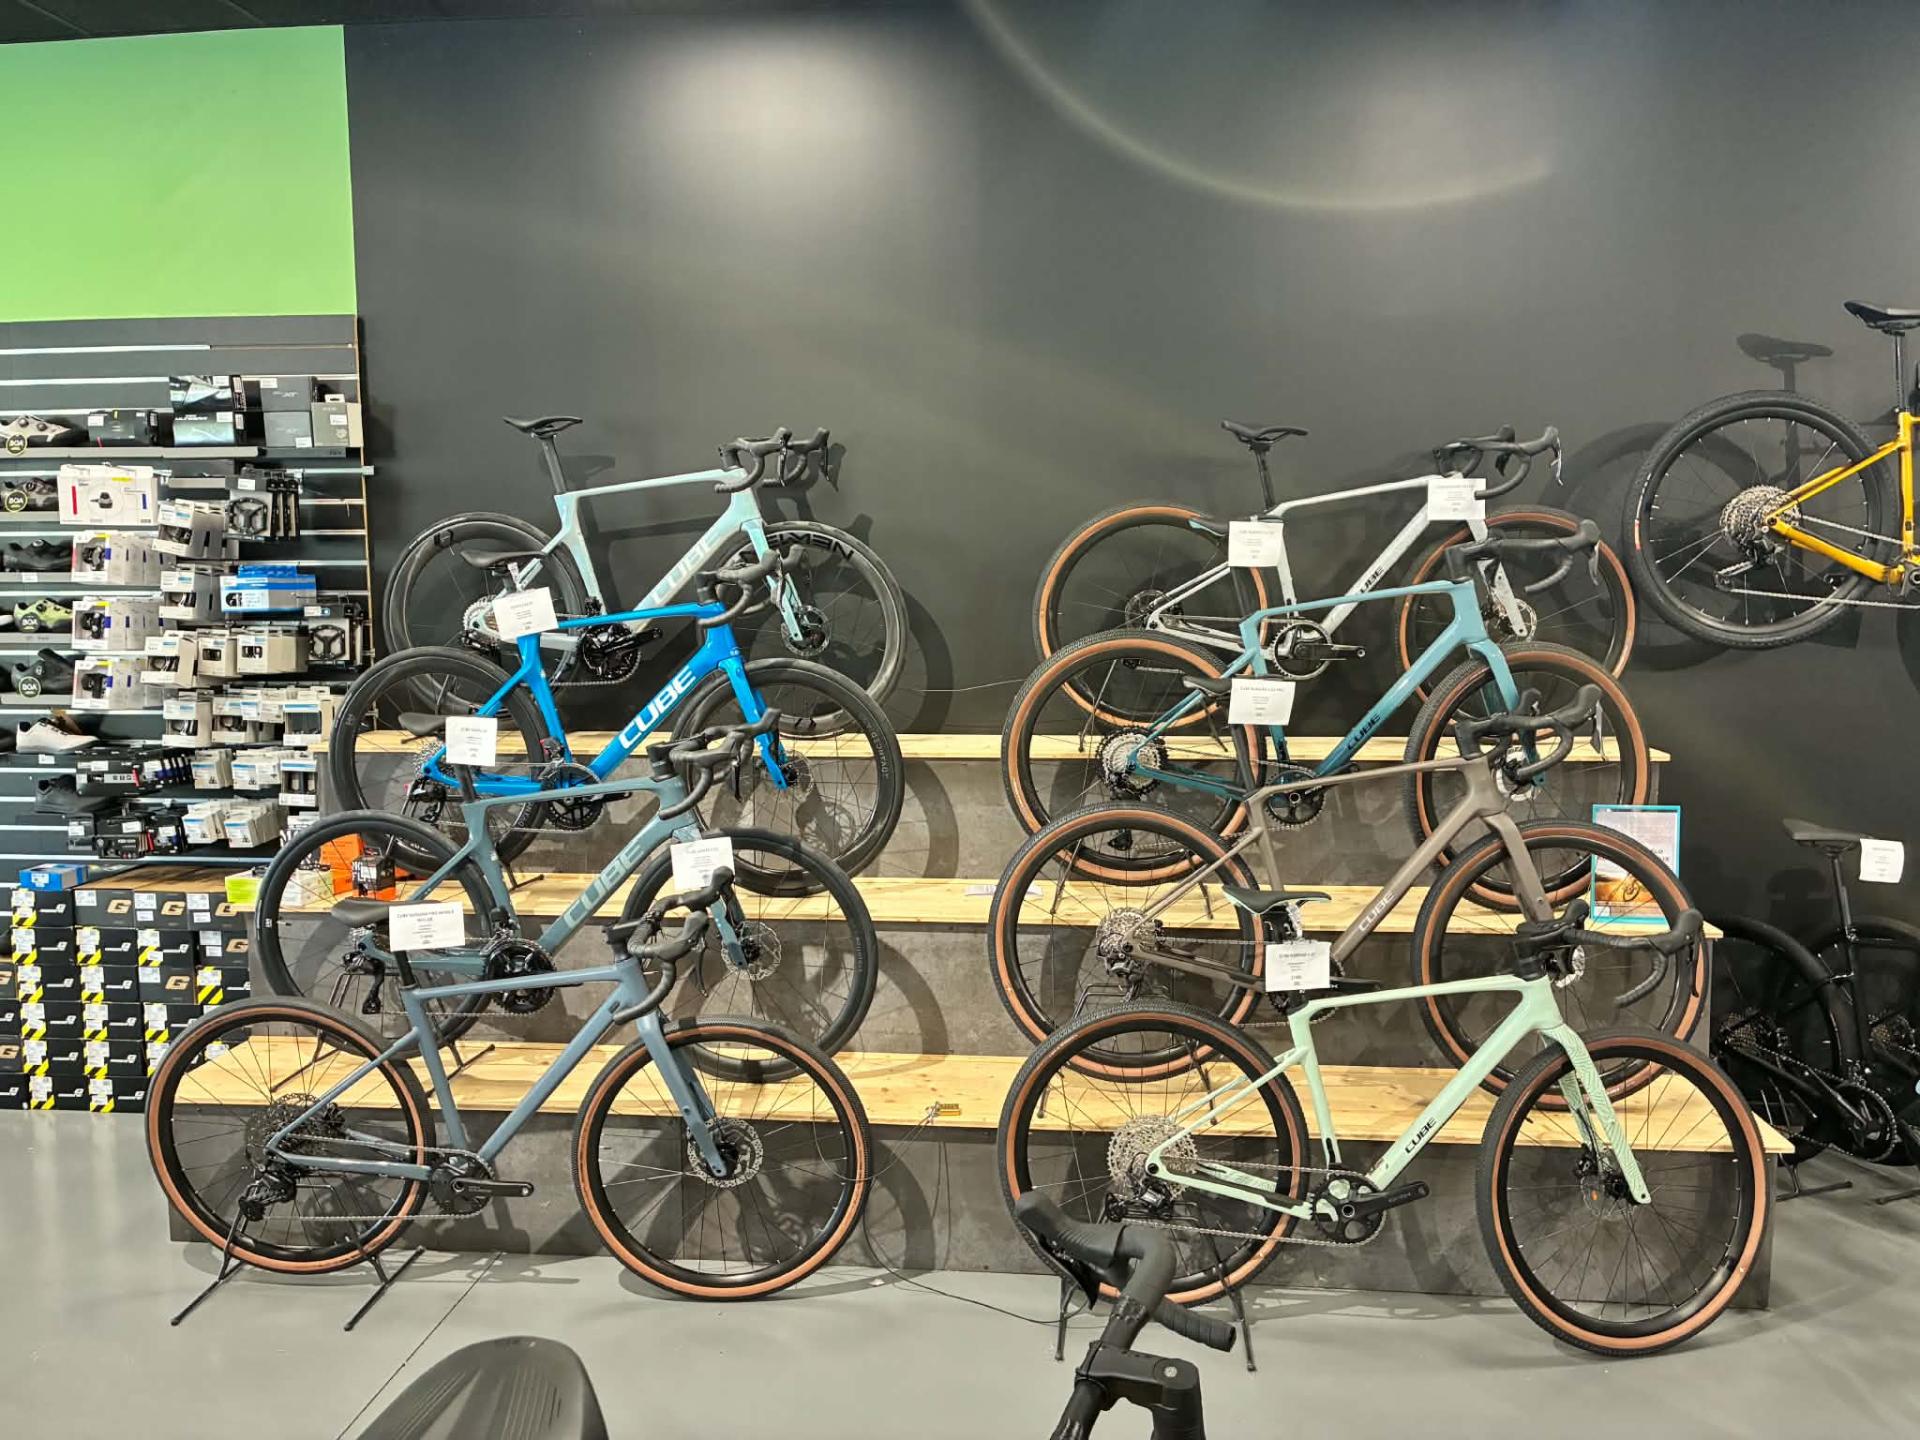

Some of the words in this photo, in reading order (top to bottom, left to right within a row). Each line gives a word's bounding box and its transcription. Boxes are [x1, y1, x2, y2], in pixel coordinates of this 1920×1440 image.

[1360, 566, 1385, 594] UBE
[618, 665, 697, 750] CUBE
[1347, 713, 1381, 750] CUBE
[563, 839, 644, 929] CUBE
[1359, 890, 1395, 932] CUBE
[1405, 1117, 1437, 1154] CUBE
